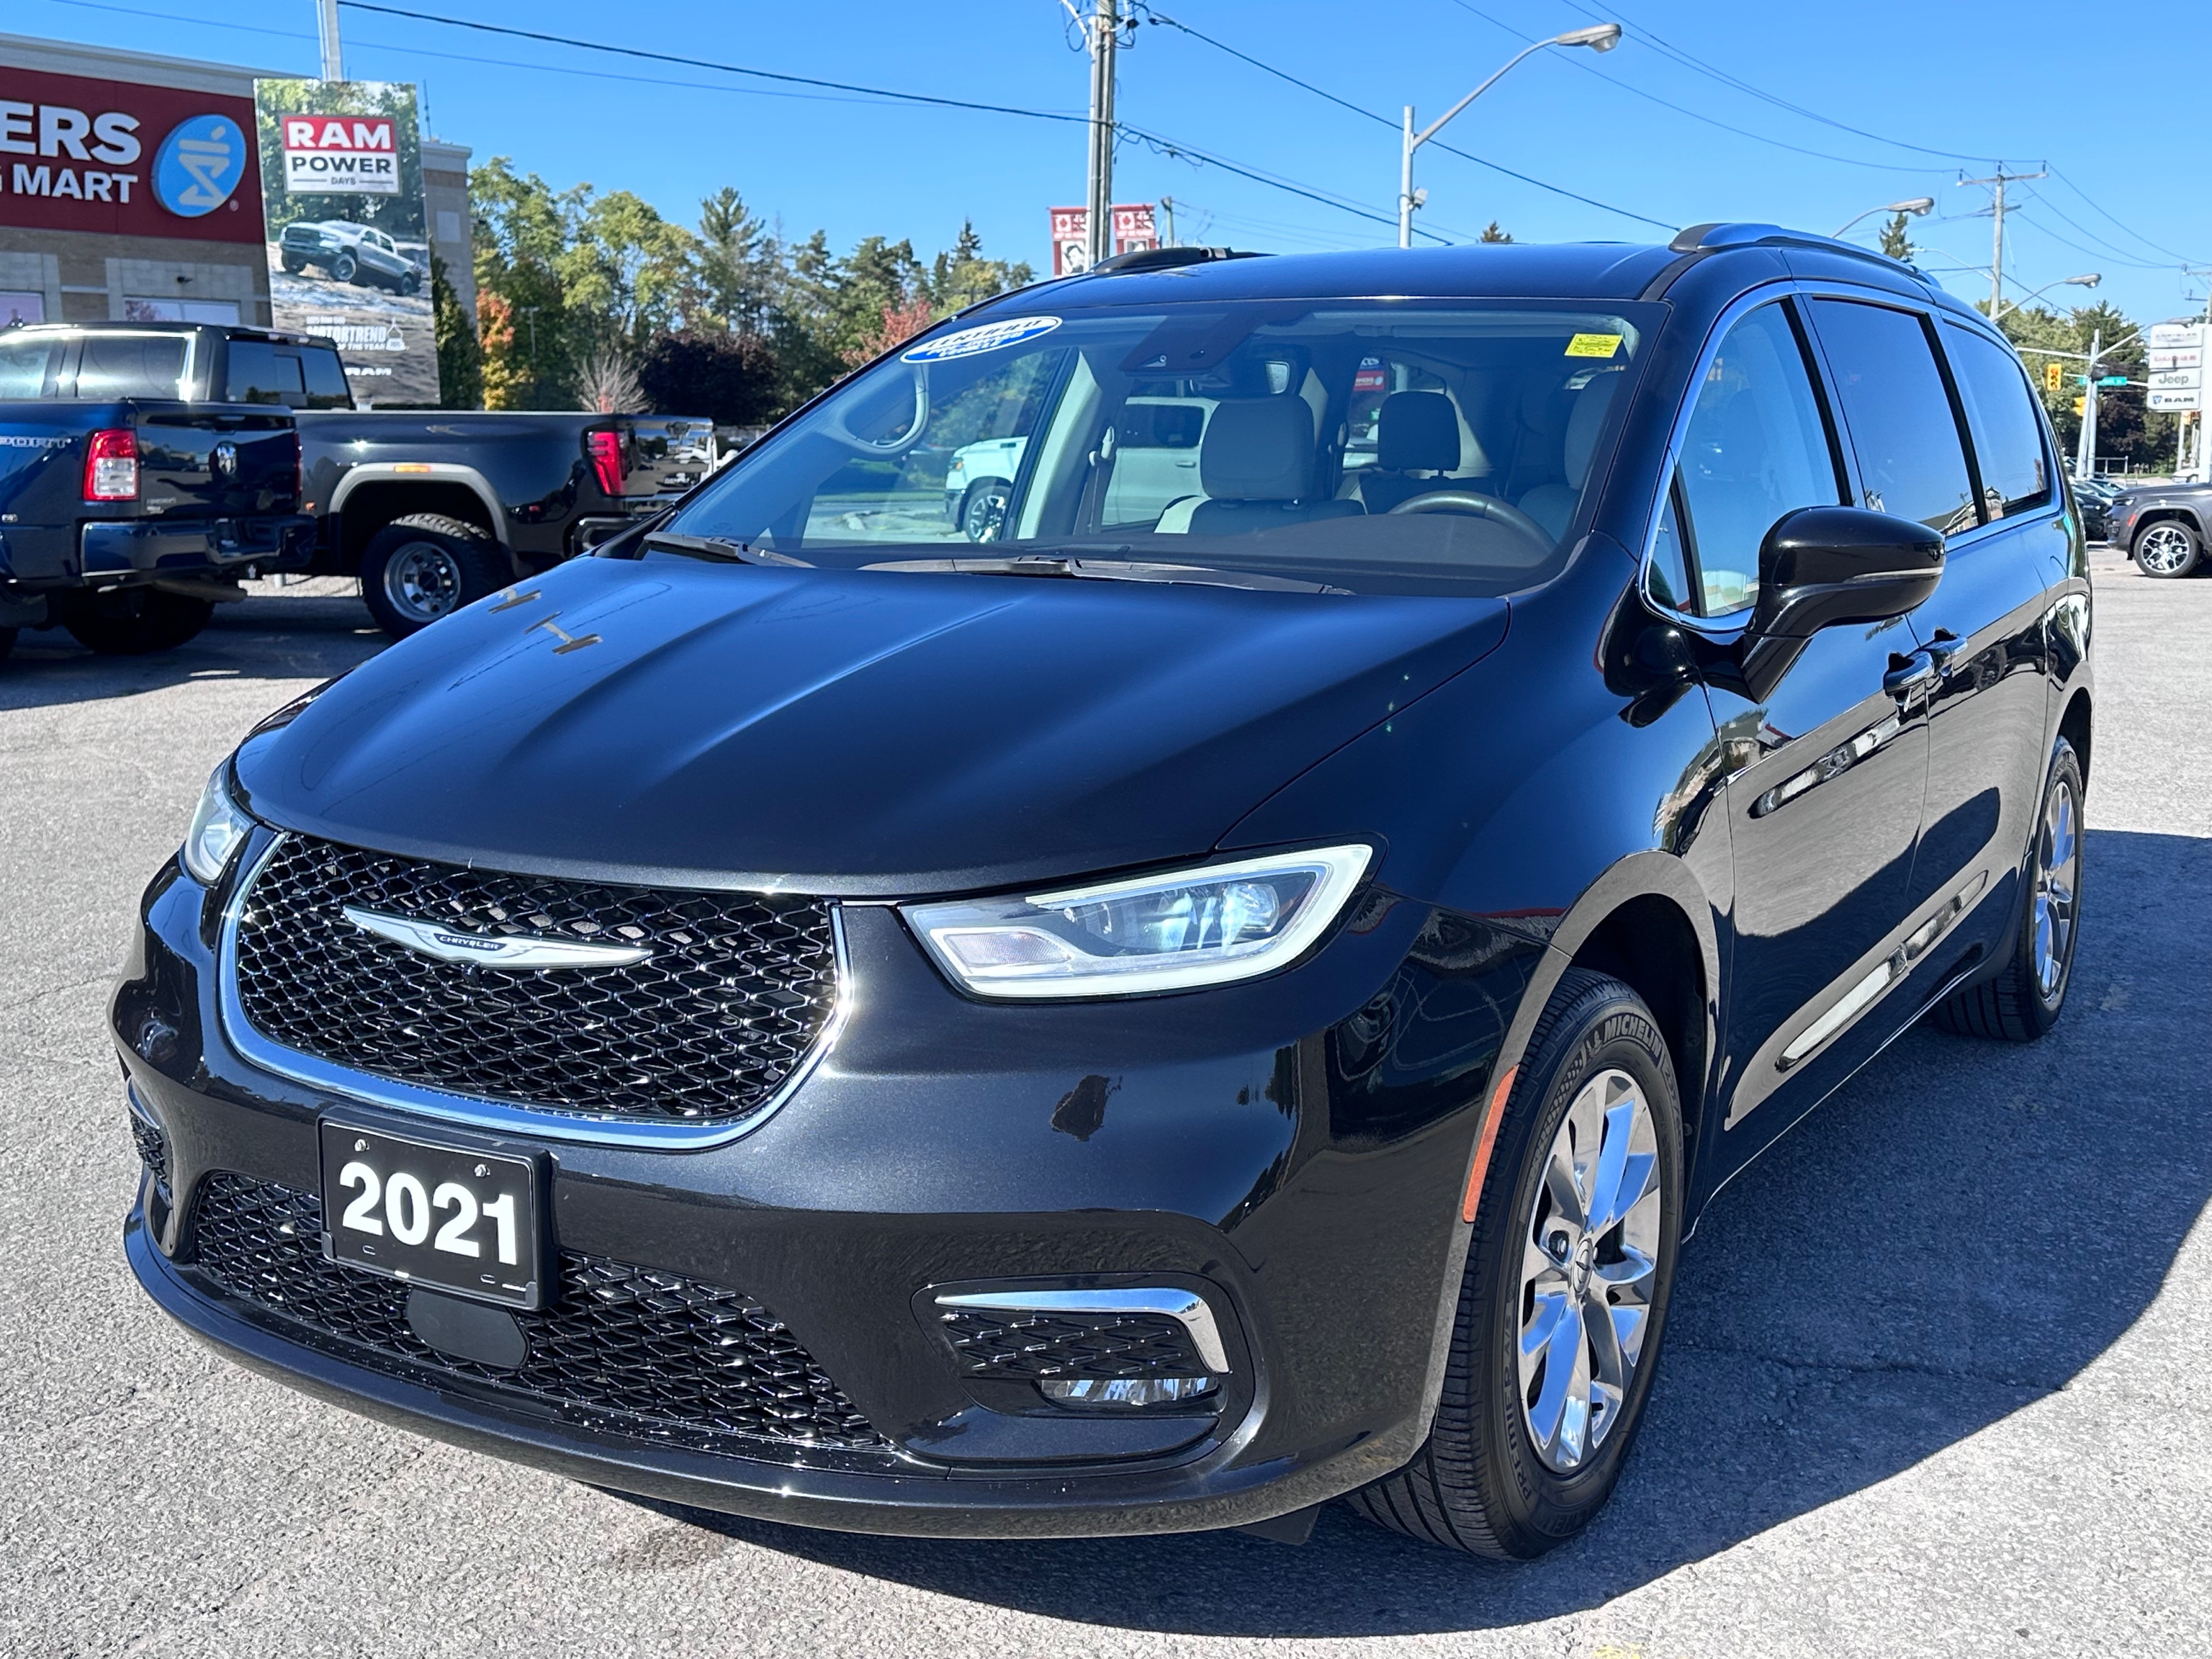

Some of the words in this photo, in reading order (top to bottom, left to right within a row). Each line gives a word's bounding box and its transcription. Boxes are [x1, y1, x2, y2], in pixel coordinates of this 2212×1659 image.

[0, 99, 142, 166] ERS
[288, 121, 392, 150] RAM
[292, 156, 392, 174] POWER
[13, 163, 138, 204] MART
[331, 176, 357, 186] DAYS
[344, 367, 392, 376] RAM
[2158, 372, 2190, 385] Jeep
[439, 935, 500, 950] CHRYSLER
[1602, 1012, 1663, 1059] MICHELIN
[339, 1161, 517, 1266] 2021
[1503, 1365, 1532, 1501] PREMIER
